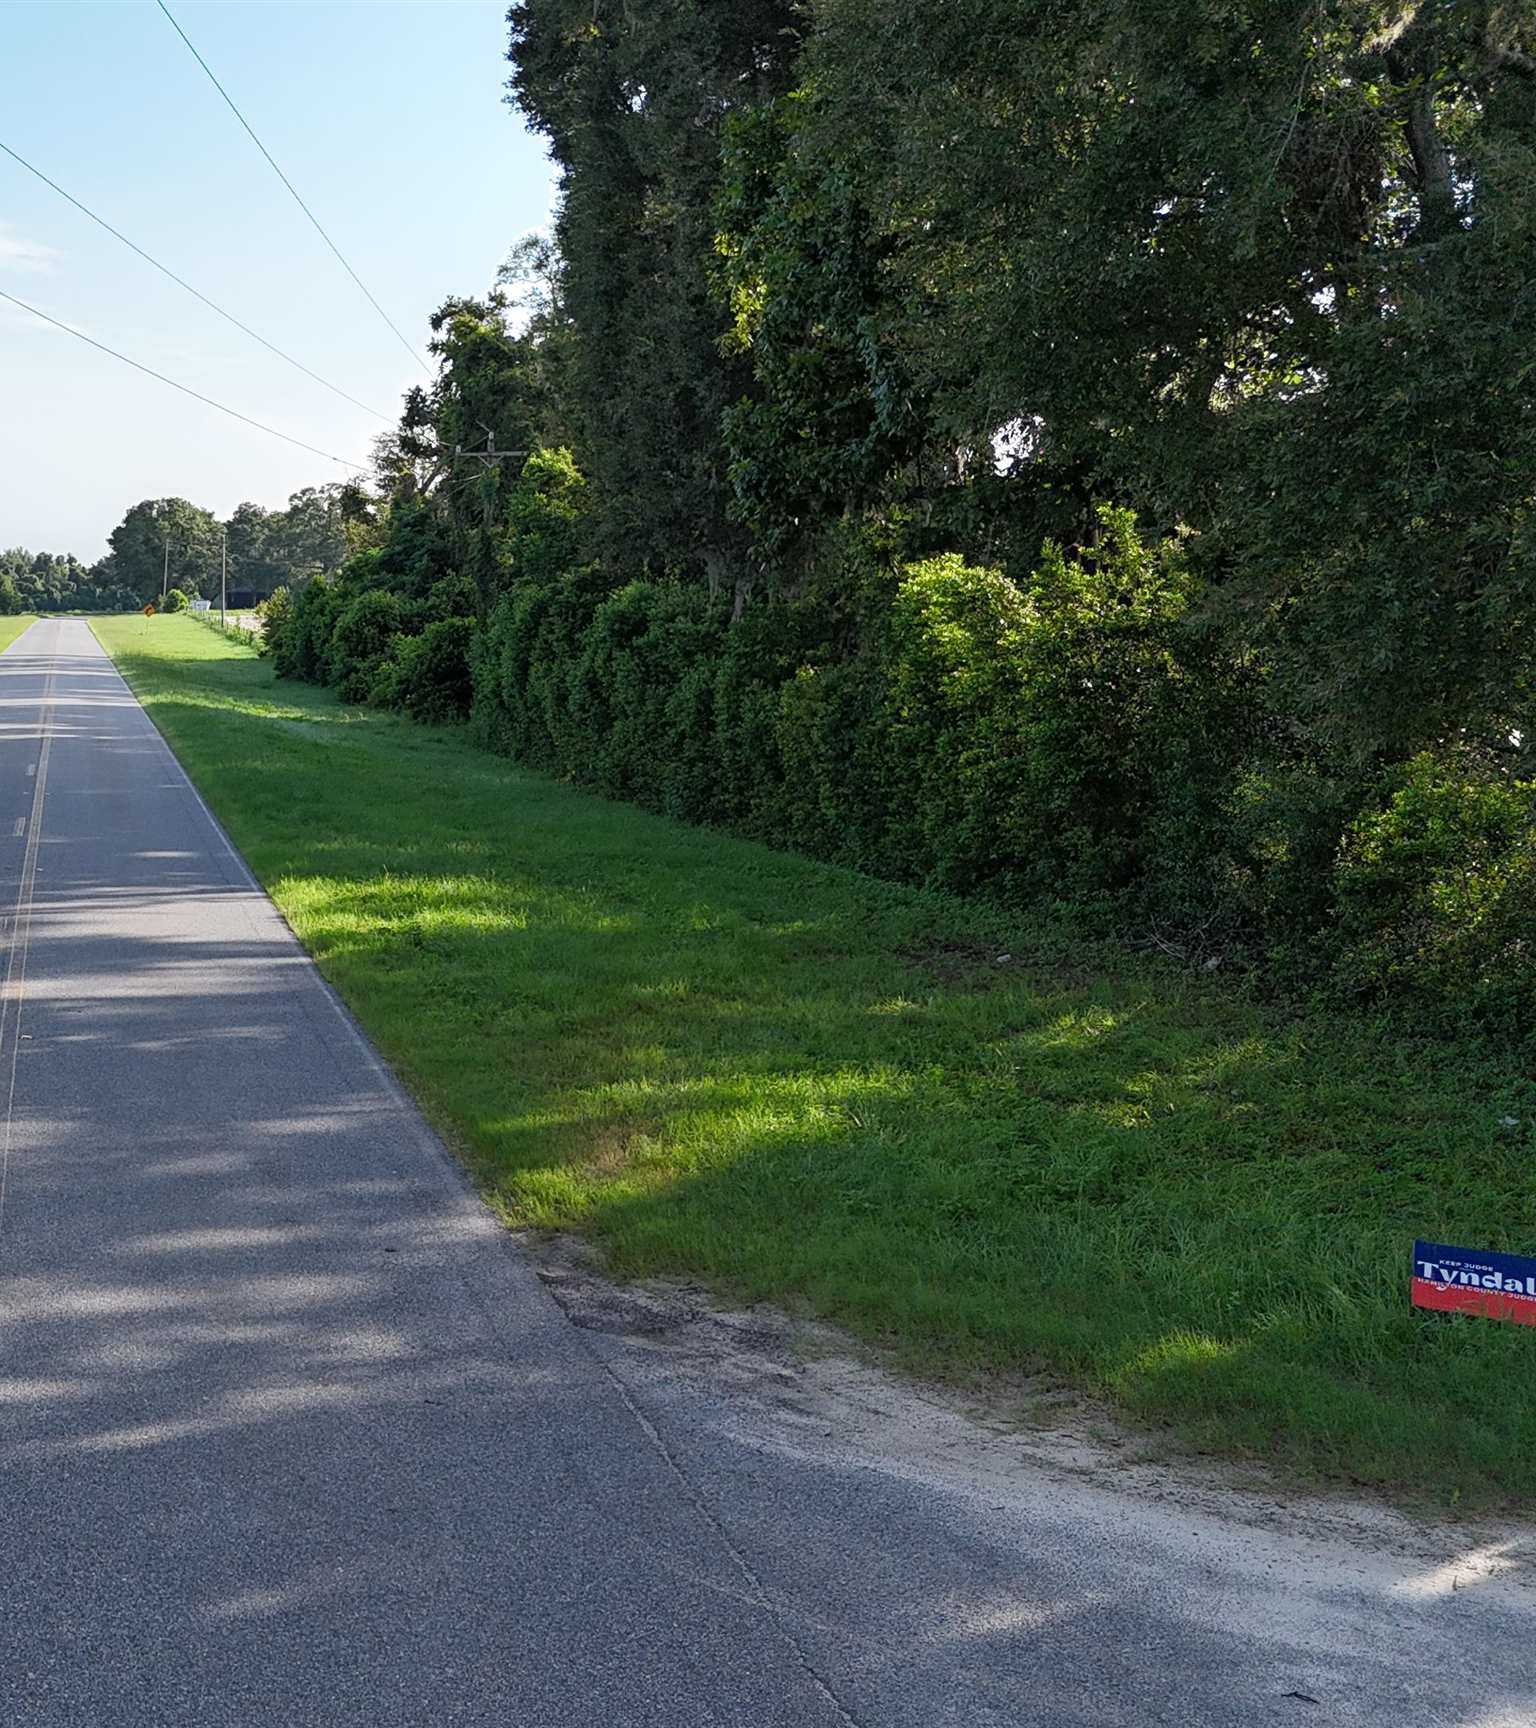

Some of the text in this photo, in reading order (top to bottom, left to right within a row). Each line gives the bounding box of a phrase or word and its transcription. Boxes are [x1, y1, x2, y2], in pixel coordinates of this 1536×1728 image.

[1463, 1263, 1494, 1272] JUDGE
[1417, 1260, 1536, 1295] Tyndal
[1465, 1285, 1506, 1296] COUNTY
